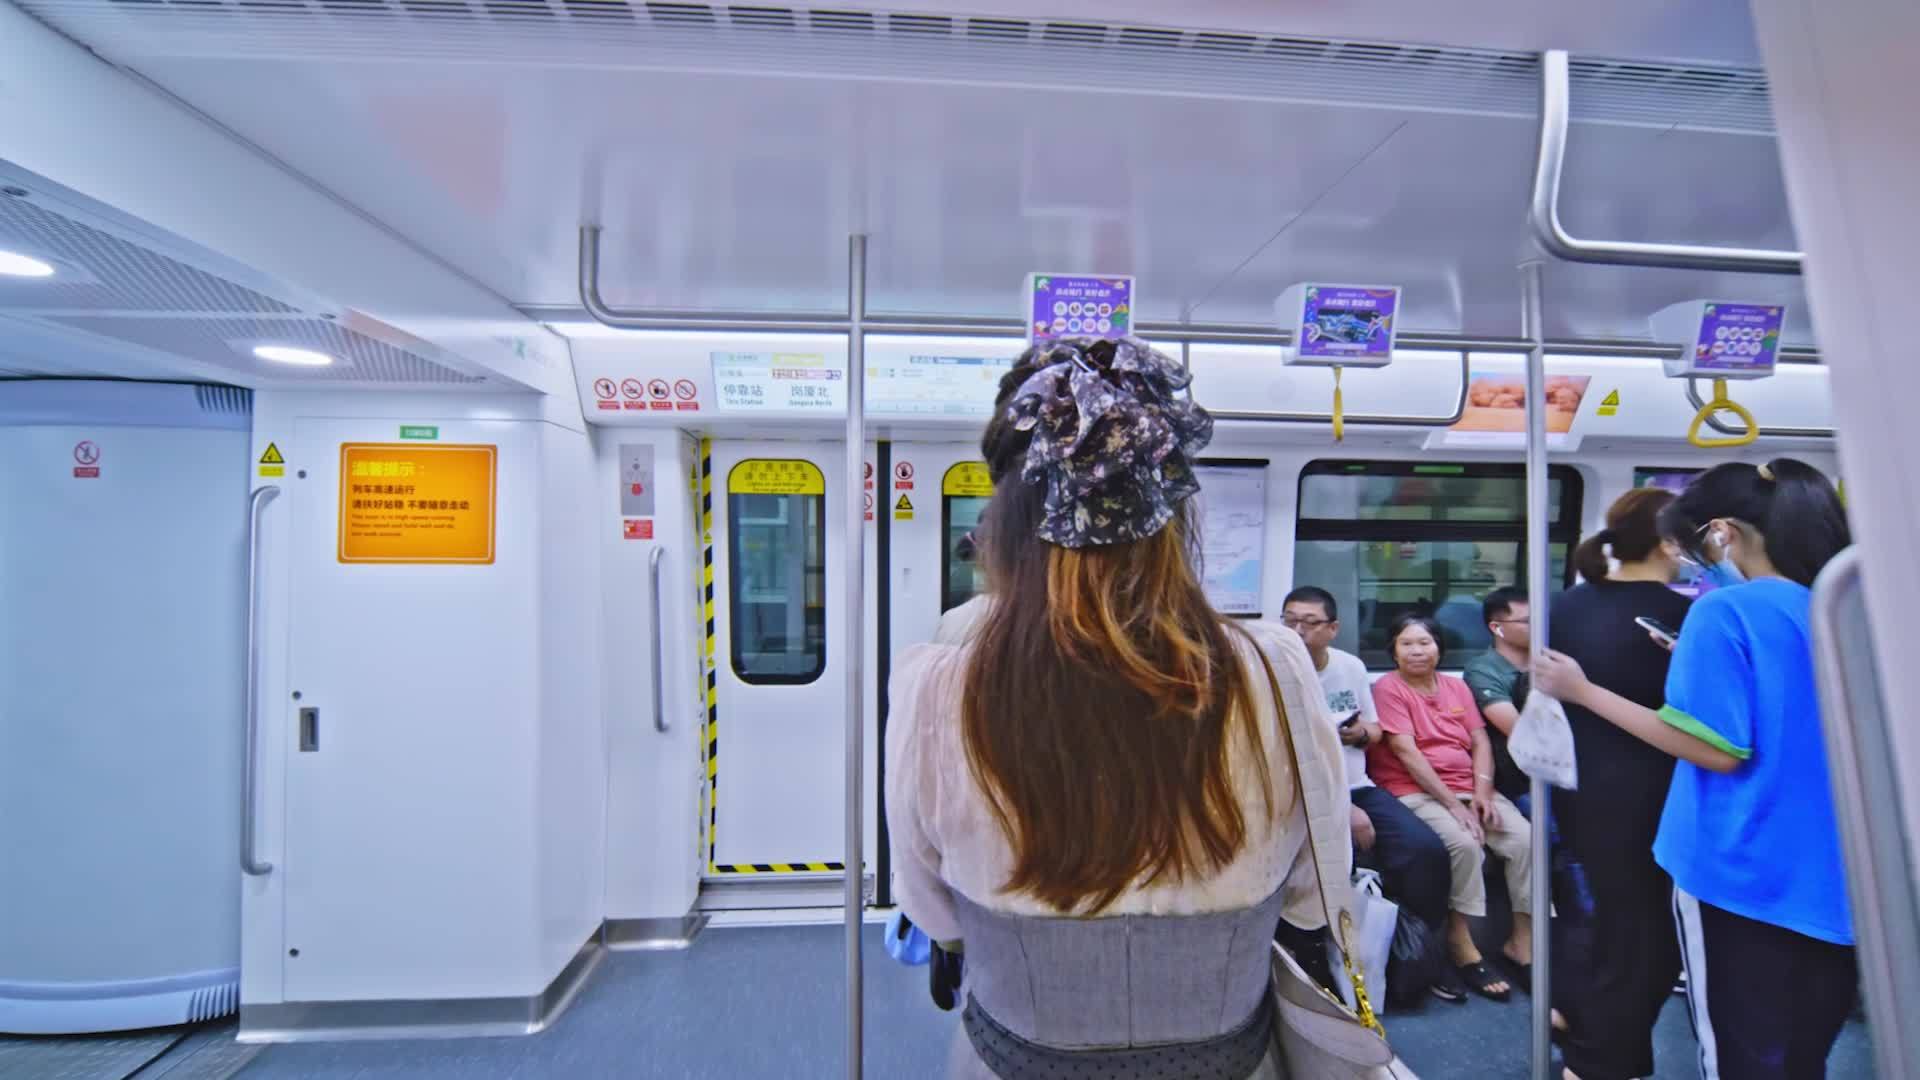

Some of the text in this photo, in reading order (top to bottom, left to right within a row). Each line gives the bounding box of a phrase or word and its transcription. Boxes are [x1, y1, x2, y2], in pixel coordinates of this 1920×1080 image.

[723, 384, 830, 398] 停靠站 岗厦北
[351, 484, 416, 495] 列车高速运行
[351, 499, 470, 511] 请扶好站稳 不要随意走动
